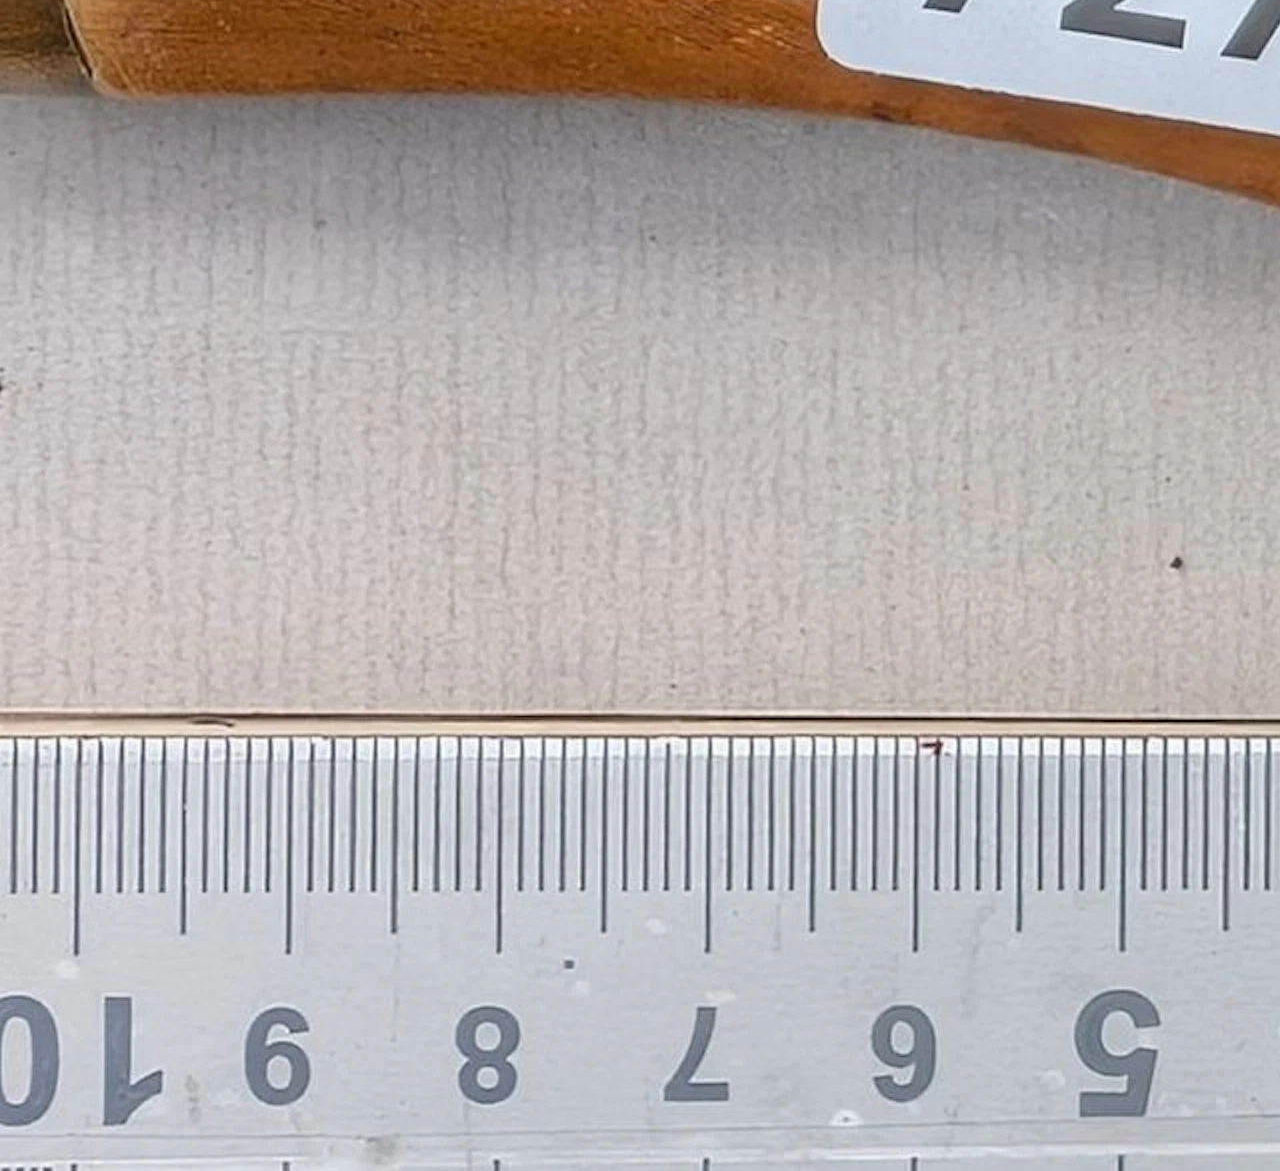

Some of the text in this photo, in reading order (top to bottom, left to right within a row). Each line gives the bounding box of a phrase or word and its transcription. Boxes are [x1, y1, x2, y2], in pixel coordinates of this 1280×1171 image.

[245, 1007, 311, 1106] 9
[455, 1006, 521, 1105] 8
[663, 1007, 730, 1102] 7
[871, 1005, 937, 1103] 6
[1074, 989, 1162, 1118] 5
